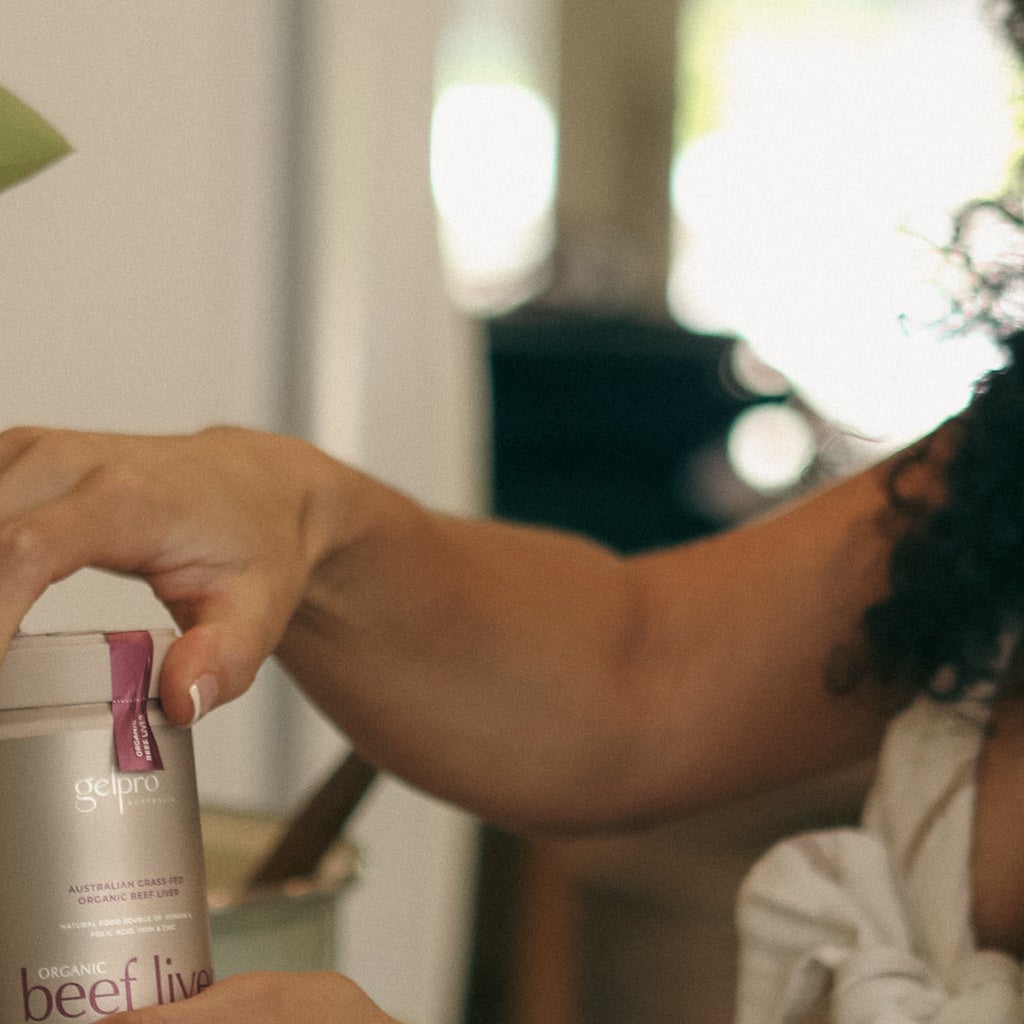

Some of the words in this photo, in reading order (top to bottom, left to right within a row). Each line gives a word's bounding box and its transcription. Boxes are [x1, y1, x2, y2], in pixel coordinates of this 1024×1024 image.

[74, 765, 160, 815] gelpro
[68, 880, 135, 894] AUSTRALIAN
[137, 876, 184, 888] GRASS-FED
[78, 892, 128, 905] ORGANIC
[130, 889, 155, 900] BEEF
[157, 888, 179, 897] LIVER
[38, 962, 107, 980] ORGANIC
[21, 957, 138, 1022] beef
[153, 955, 212, 1005] live
